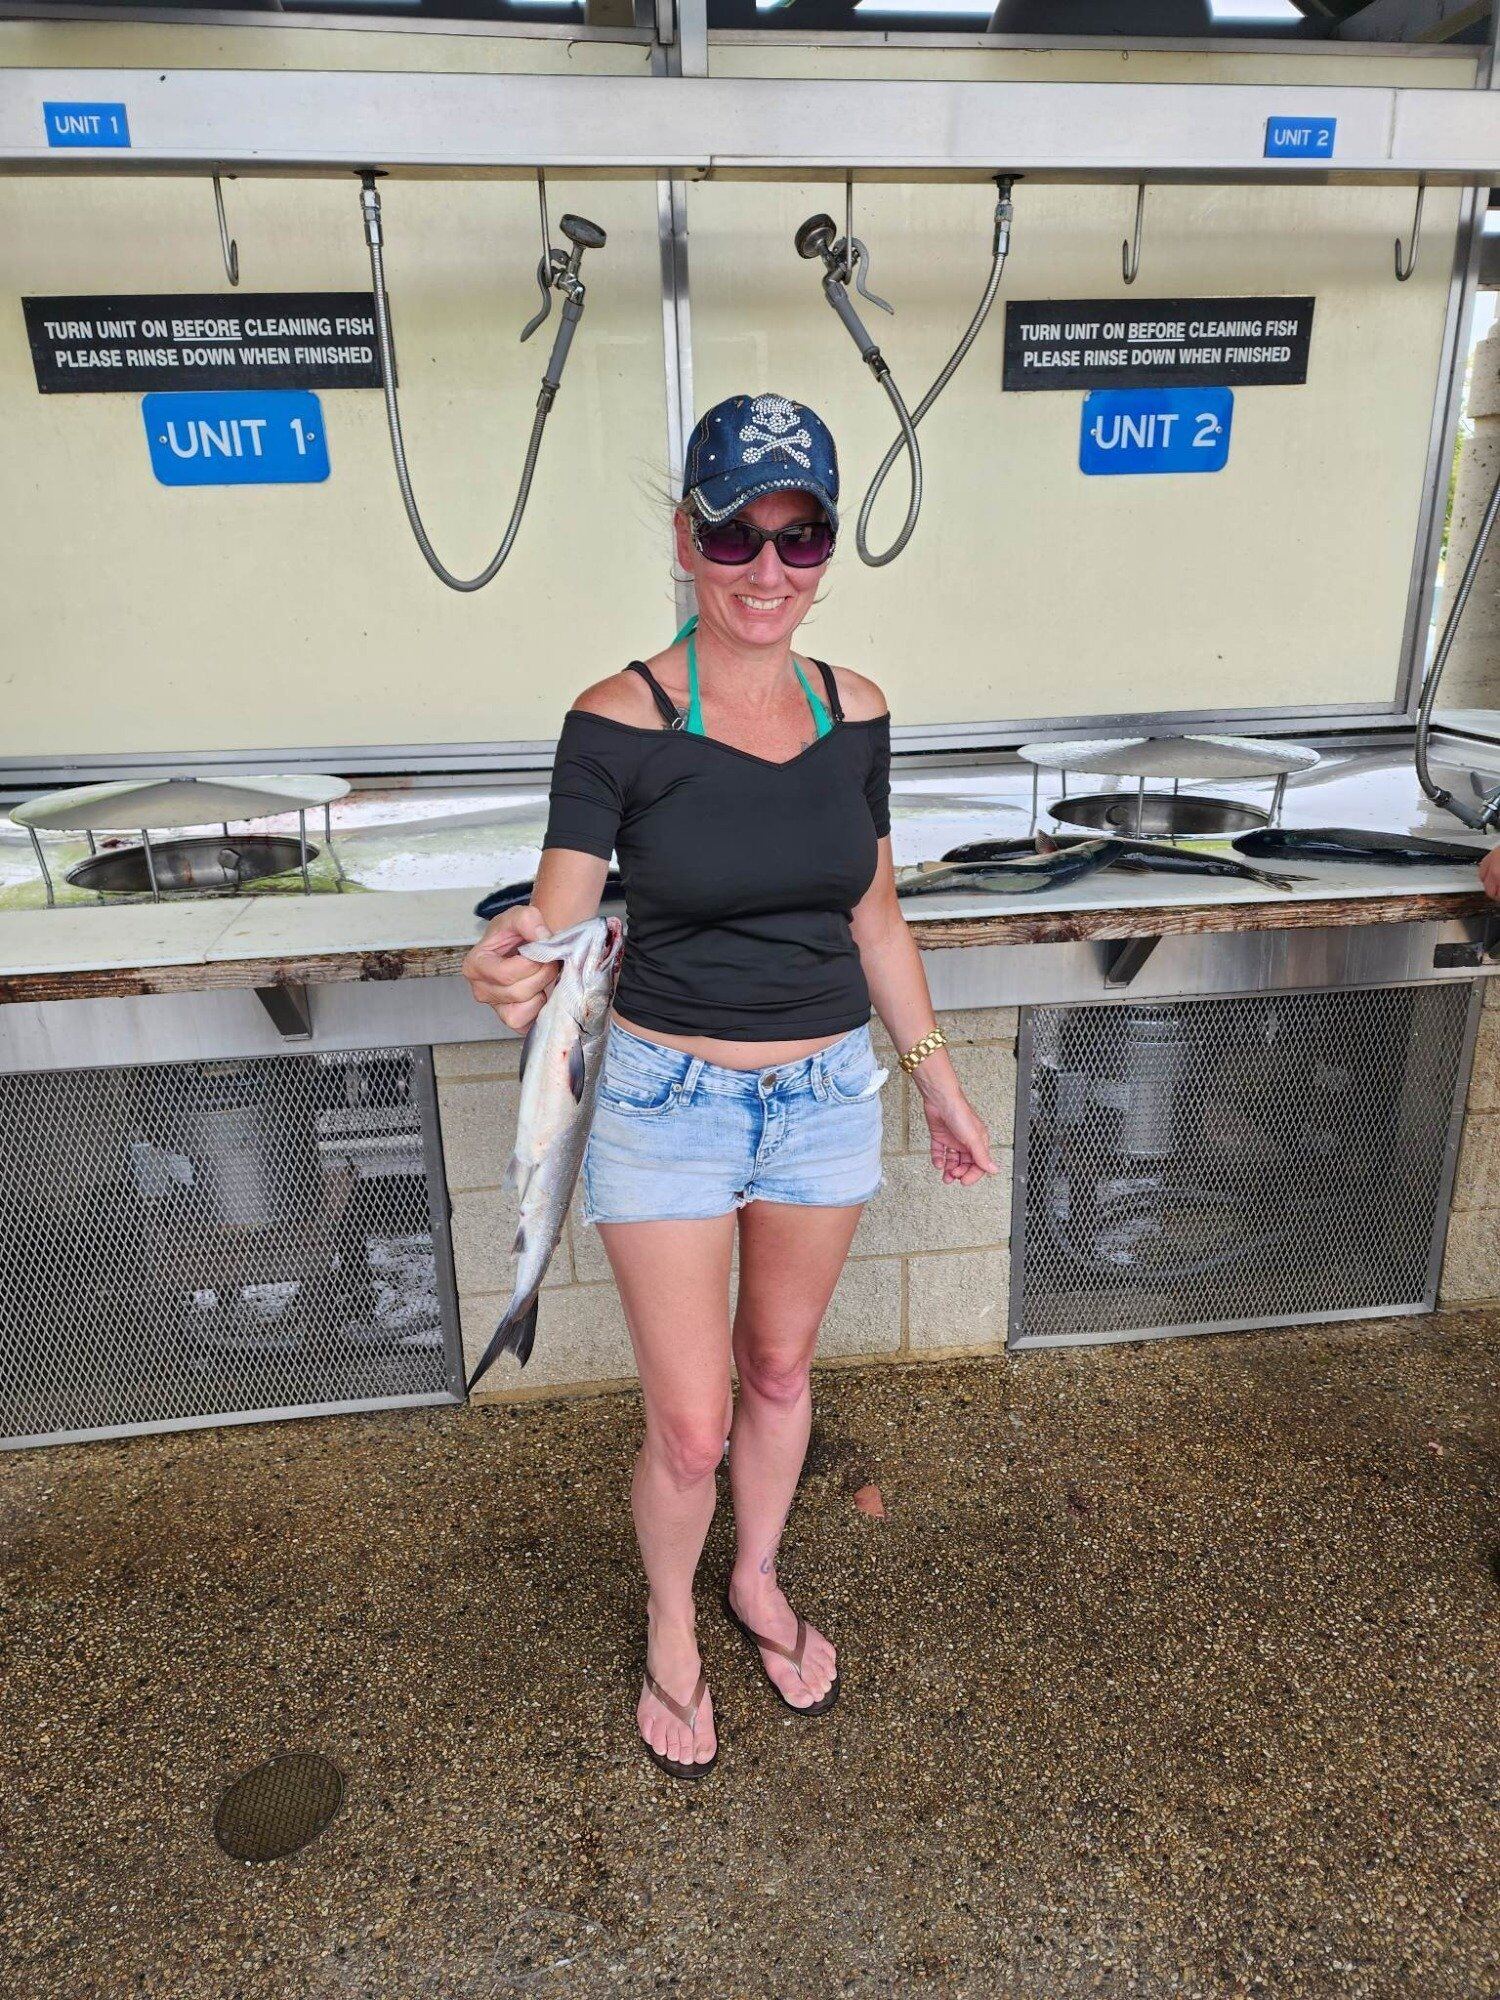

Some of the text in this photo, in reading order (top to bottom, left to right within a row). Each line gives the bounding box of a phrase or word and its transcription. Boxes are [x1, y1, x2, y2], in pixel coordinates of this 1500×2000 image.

[55, 115, 119, 134] UNIT 1
[1274, 129, 1329, 146] UNIT 2
[44, 317, 374, 340] TURN UNIT ON BEFORE CLEANING FISH
[1020, 319, 1298, 341] TURN UNIT ON BEFORE CLEANING FISH
[55, 346, 373, 368] PLEASE RINSE DOWN WHEN FINISHED
[1023, 346, 1291, 368] PLEASE RINSE DOWN WHEN FINISHED
[166, 418, 307, 459] UNIT 1
[1094, 412, 1220, 449] UNIT 2
